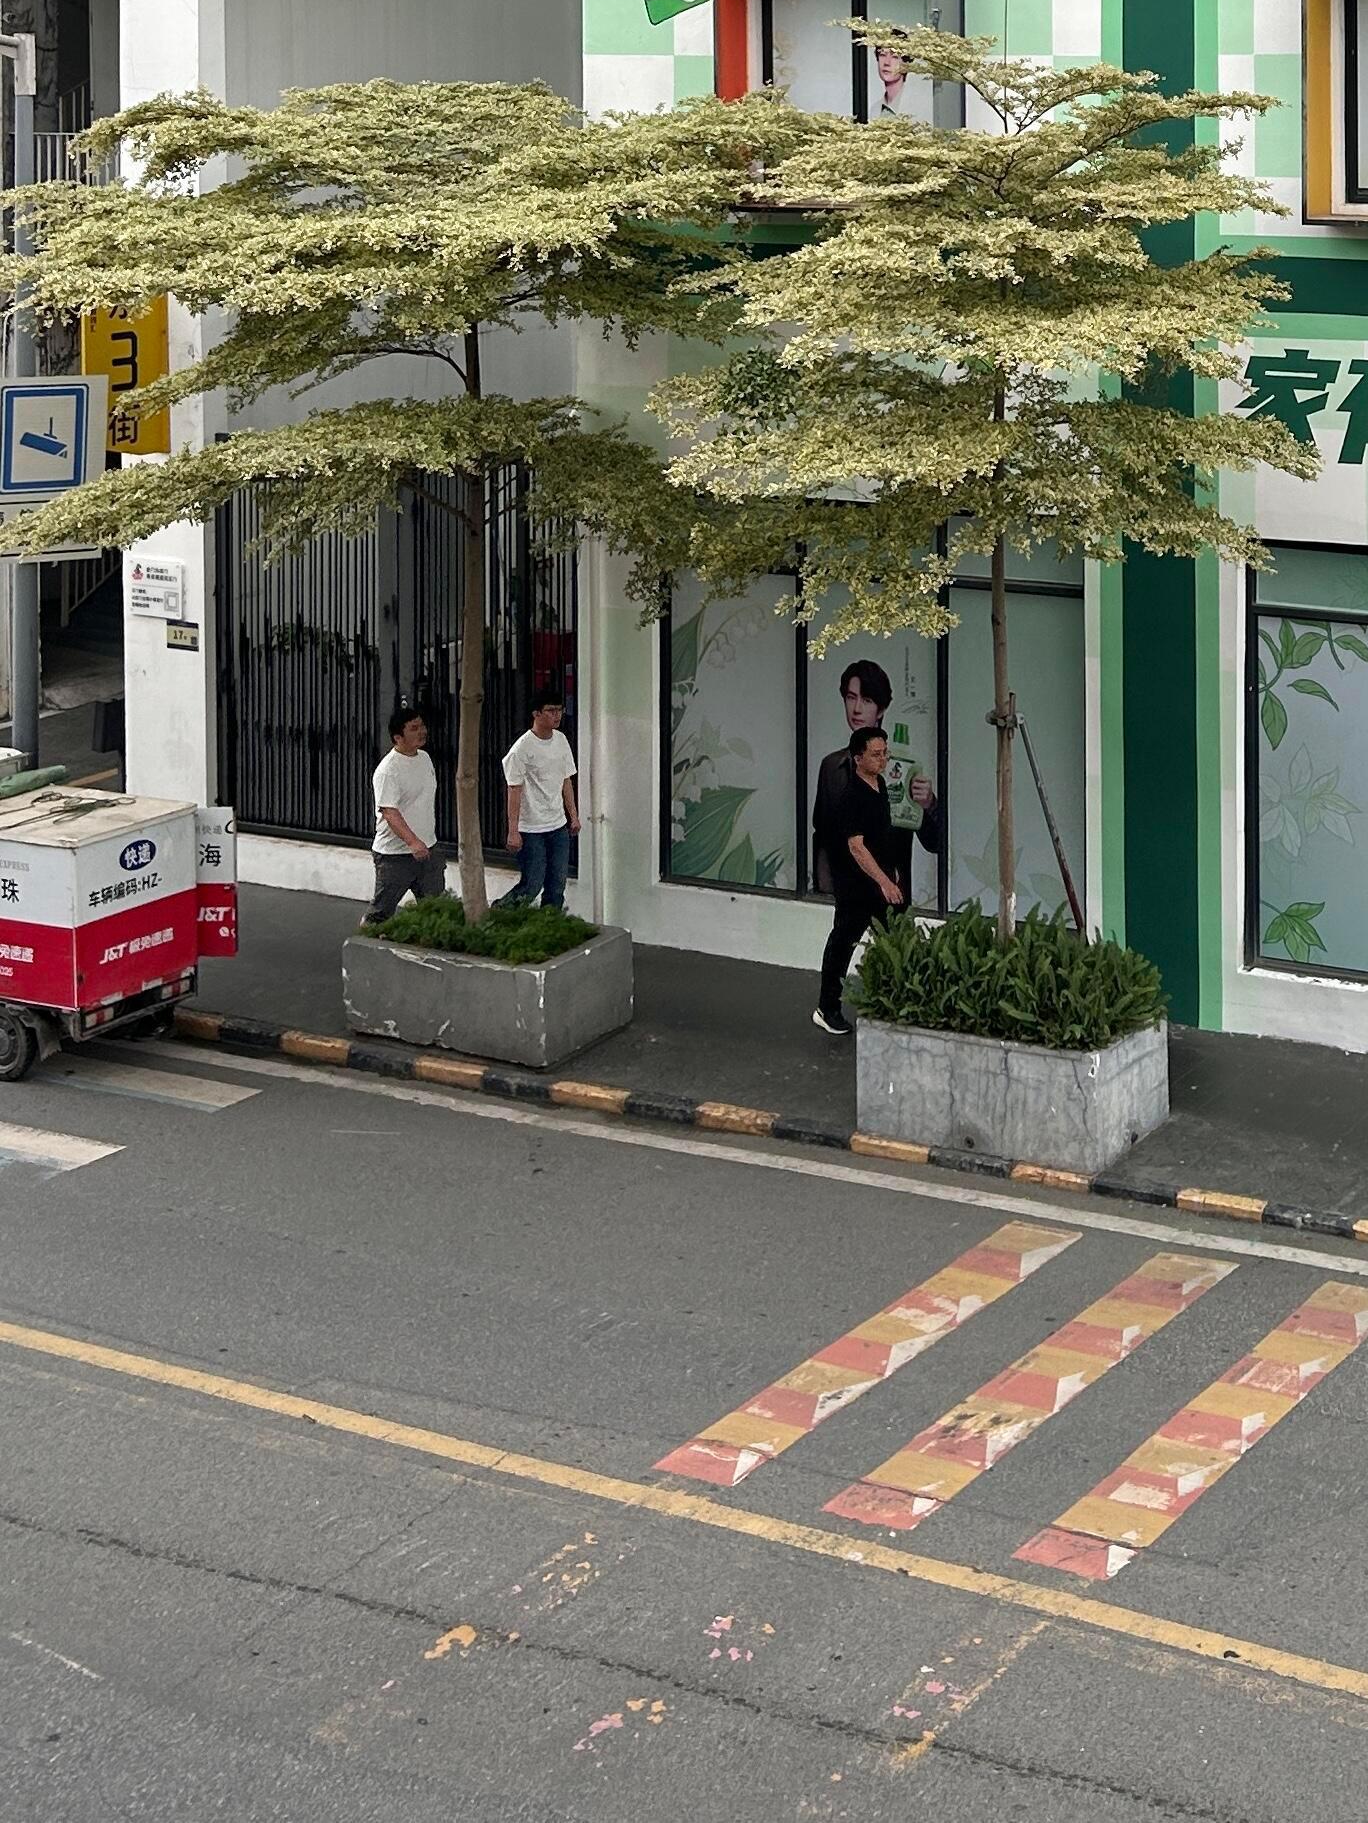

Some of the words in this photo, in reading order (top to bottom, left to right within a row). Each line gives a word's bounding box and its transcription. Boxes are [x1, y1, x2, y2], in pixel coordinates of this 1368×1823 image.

[124, 842, 151, 868] 快递
[199, 843, 221, 867] 海
[1, 878, 20, 904] 珠
[99, 940, 129, 965] J&T
